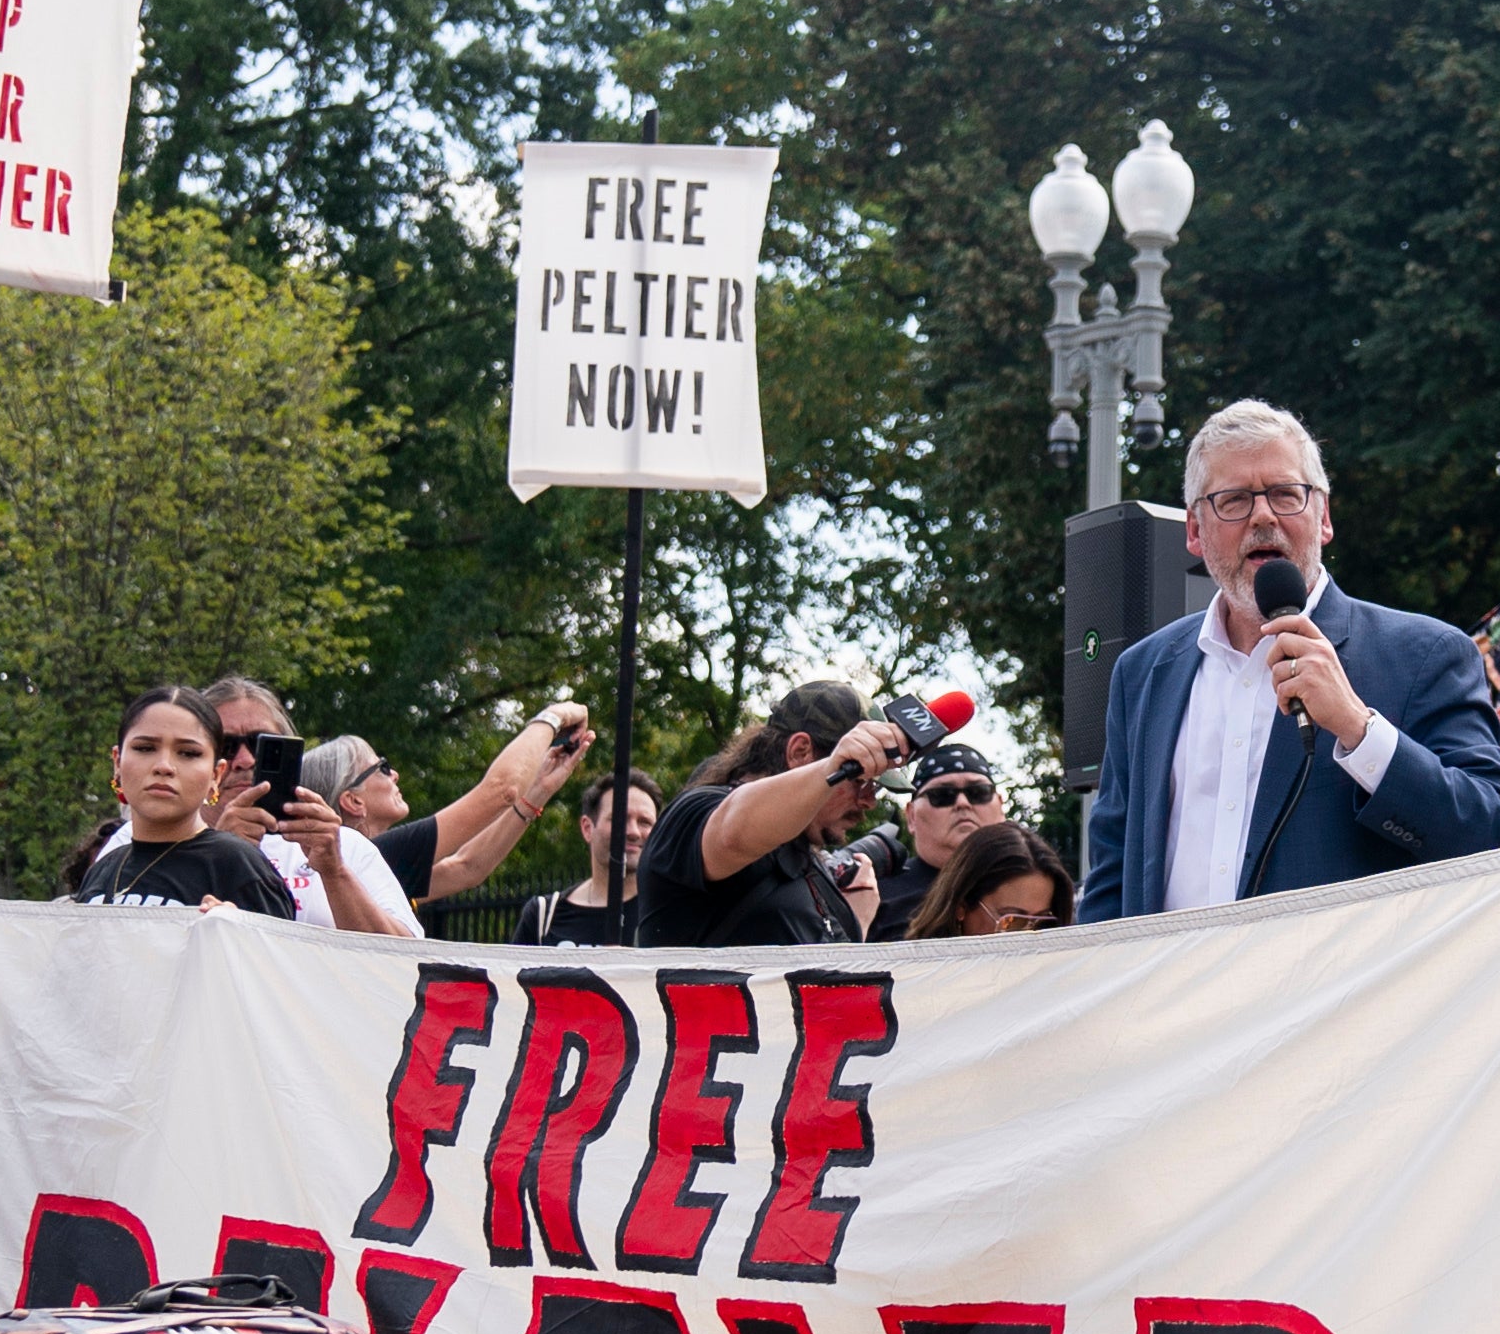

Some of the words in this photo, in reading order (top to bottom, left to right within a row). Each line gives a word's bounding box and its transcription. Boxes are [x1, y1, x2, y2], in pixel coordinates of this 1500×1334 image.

[584, 177, 708, 246] FREE
[541, 268, 744, 343] PELTIER
[566, 363, 705, 435] NOW!
[353, 962, 895, 1284] FREE
